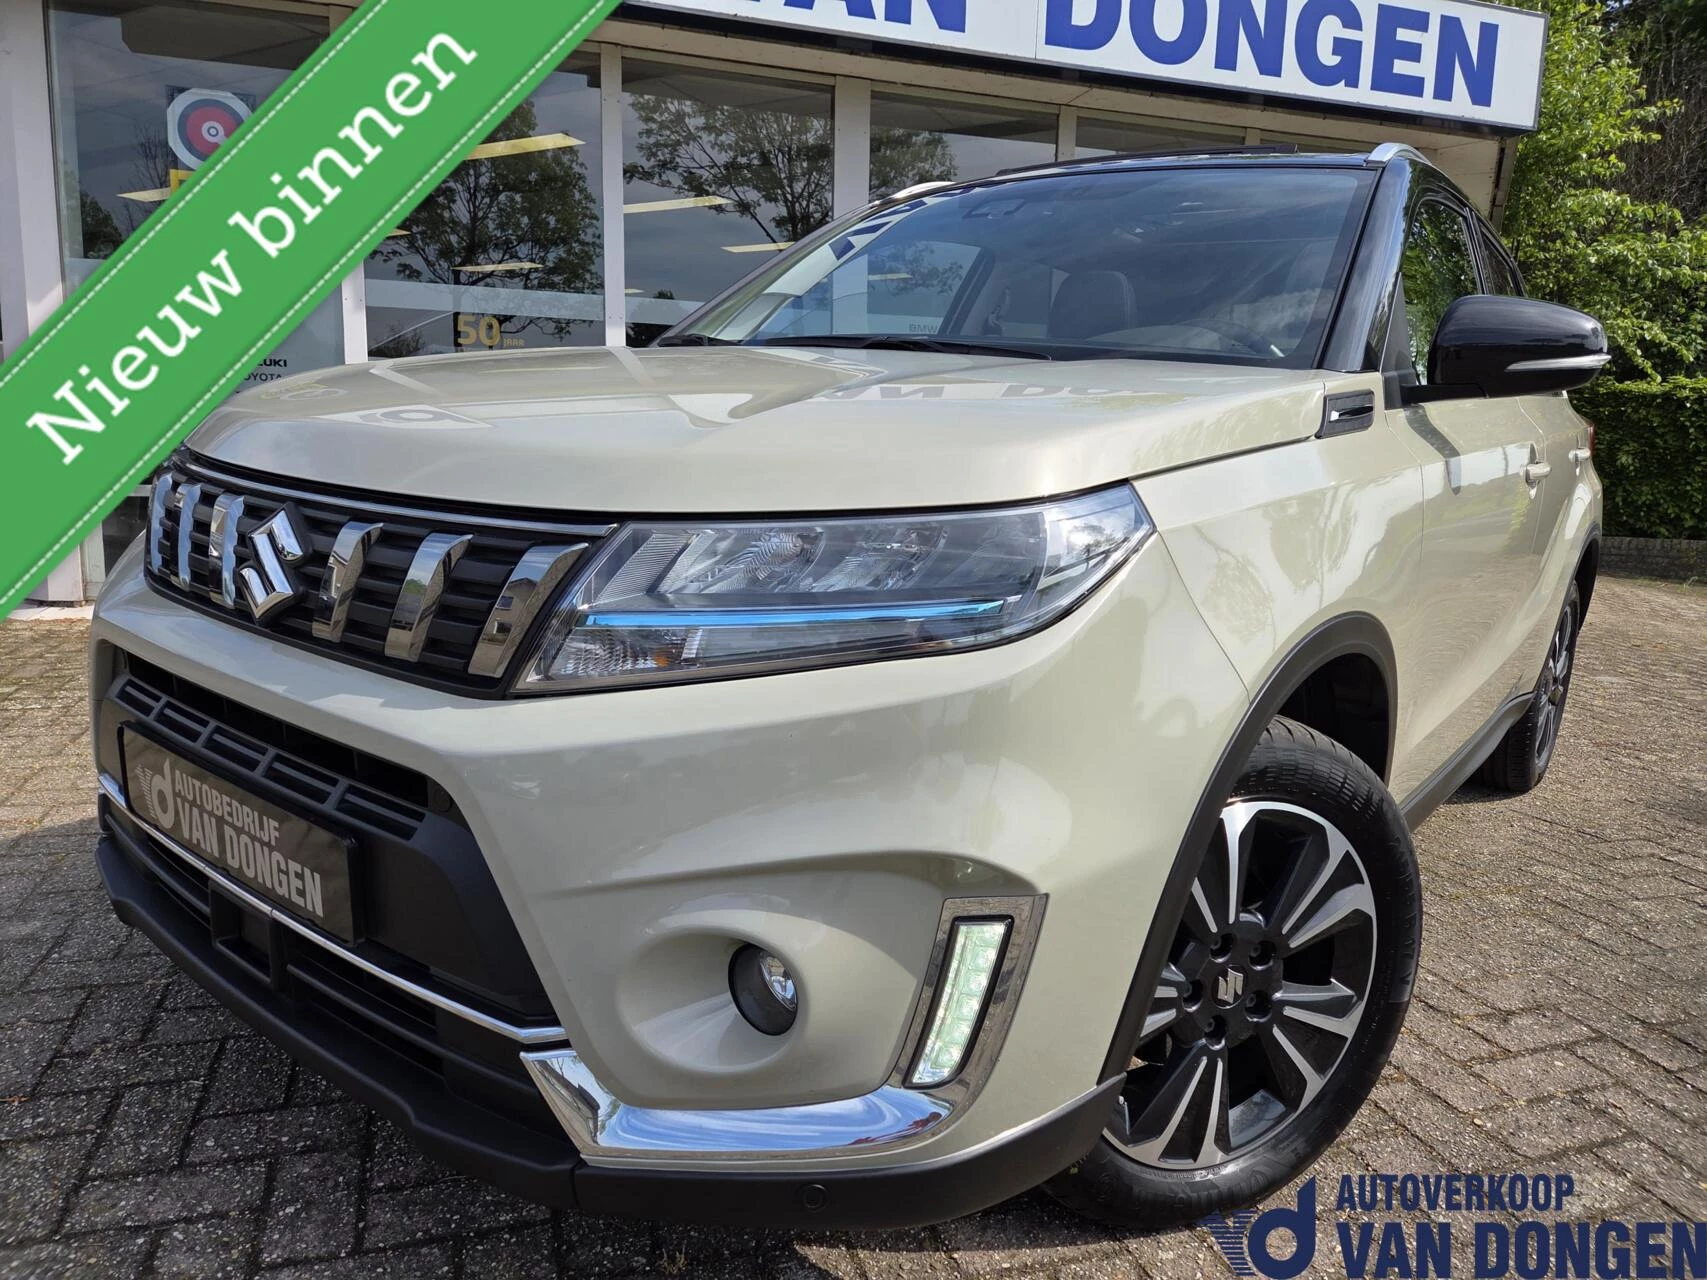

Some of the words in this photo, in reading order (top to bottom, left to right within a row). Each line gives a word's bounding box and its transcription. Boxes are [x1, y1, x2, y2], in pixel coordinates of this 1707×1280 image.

[457, 314, 501, 347] 50
[175, 769, 280, 846] AUTOBEDRIJF
[176, 796, 219, 858] VAN
[224, 825, 324, 918] DONGEN
